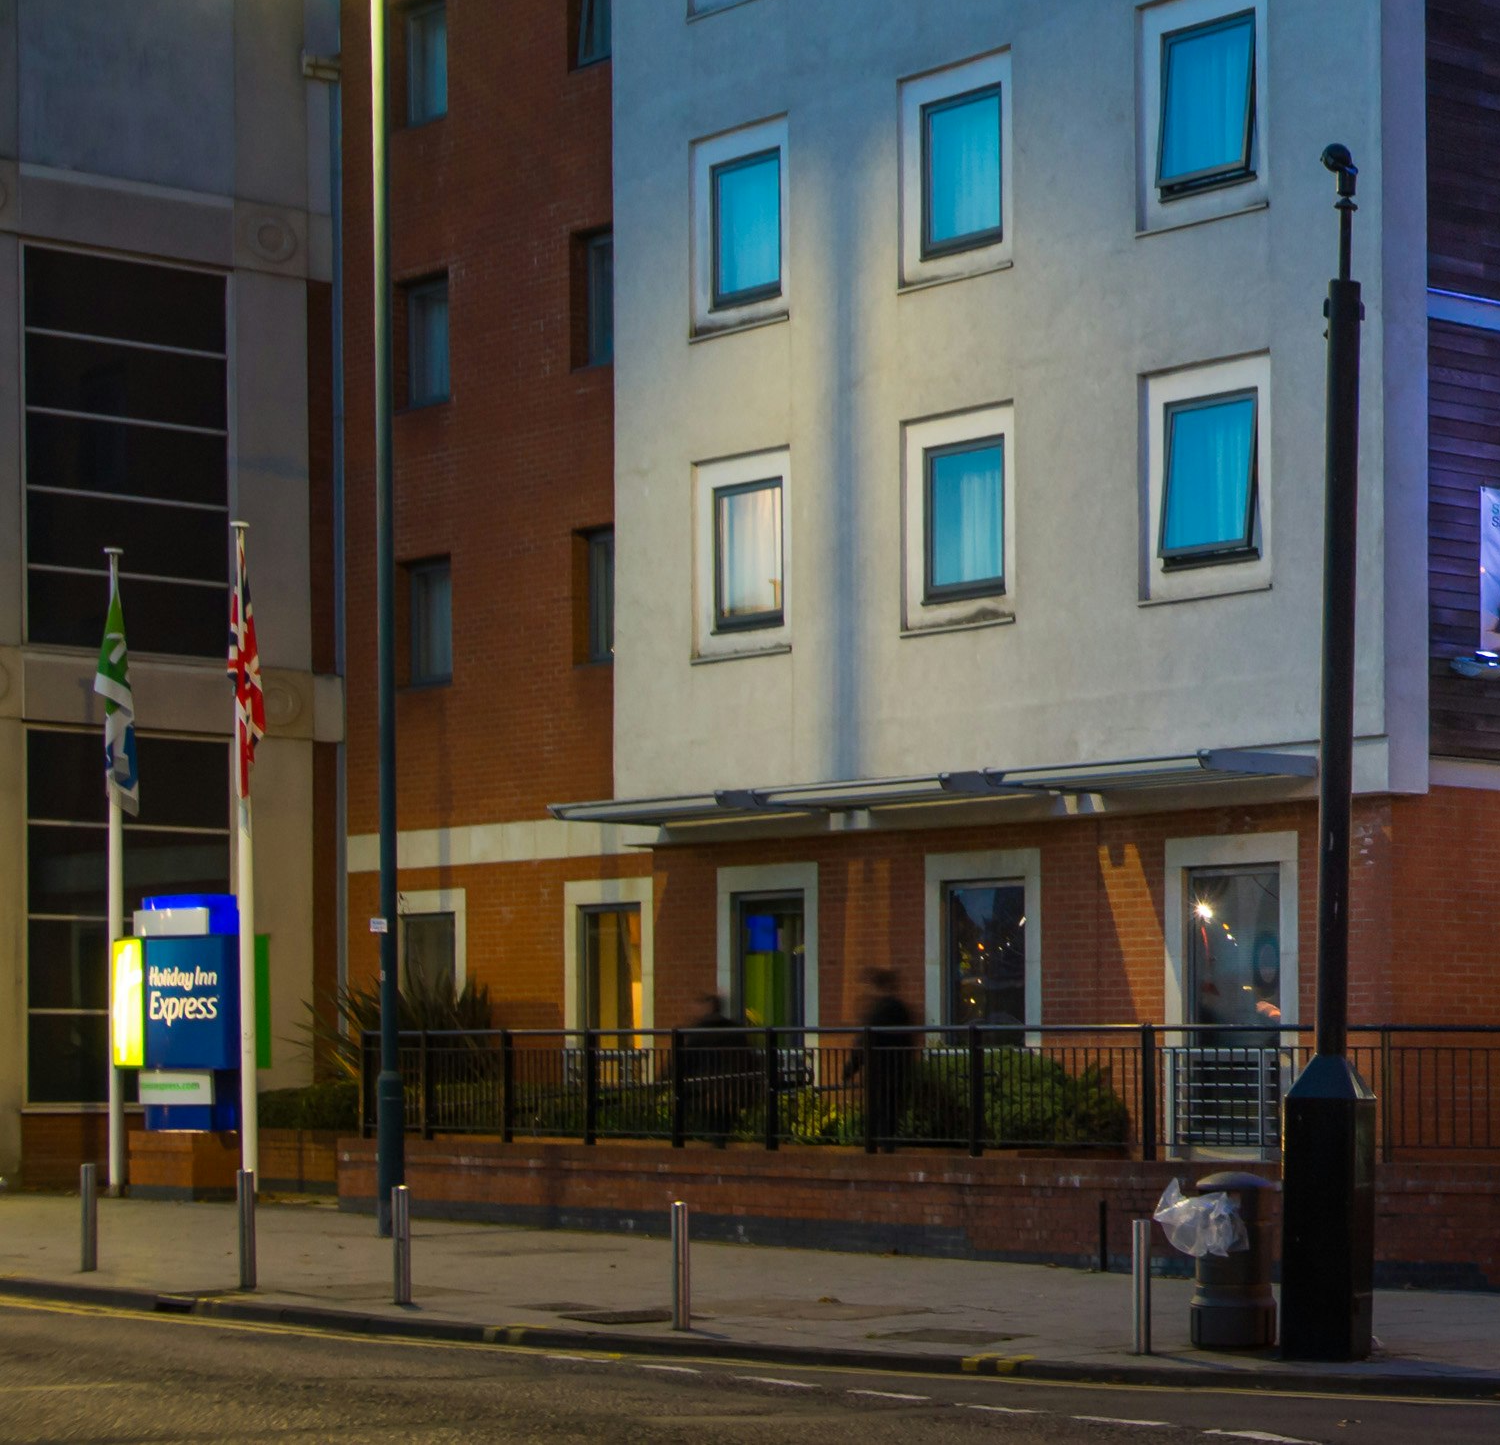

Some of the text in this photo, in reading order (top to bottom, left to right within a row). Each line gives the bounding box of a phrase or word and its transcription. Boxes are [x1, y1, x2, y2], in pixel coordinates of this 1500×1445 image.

[149, 965, 218, 992] Holiday Inn
[149, 990, 219, 1027] Express
